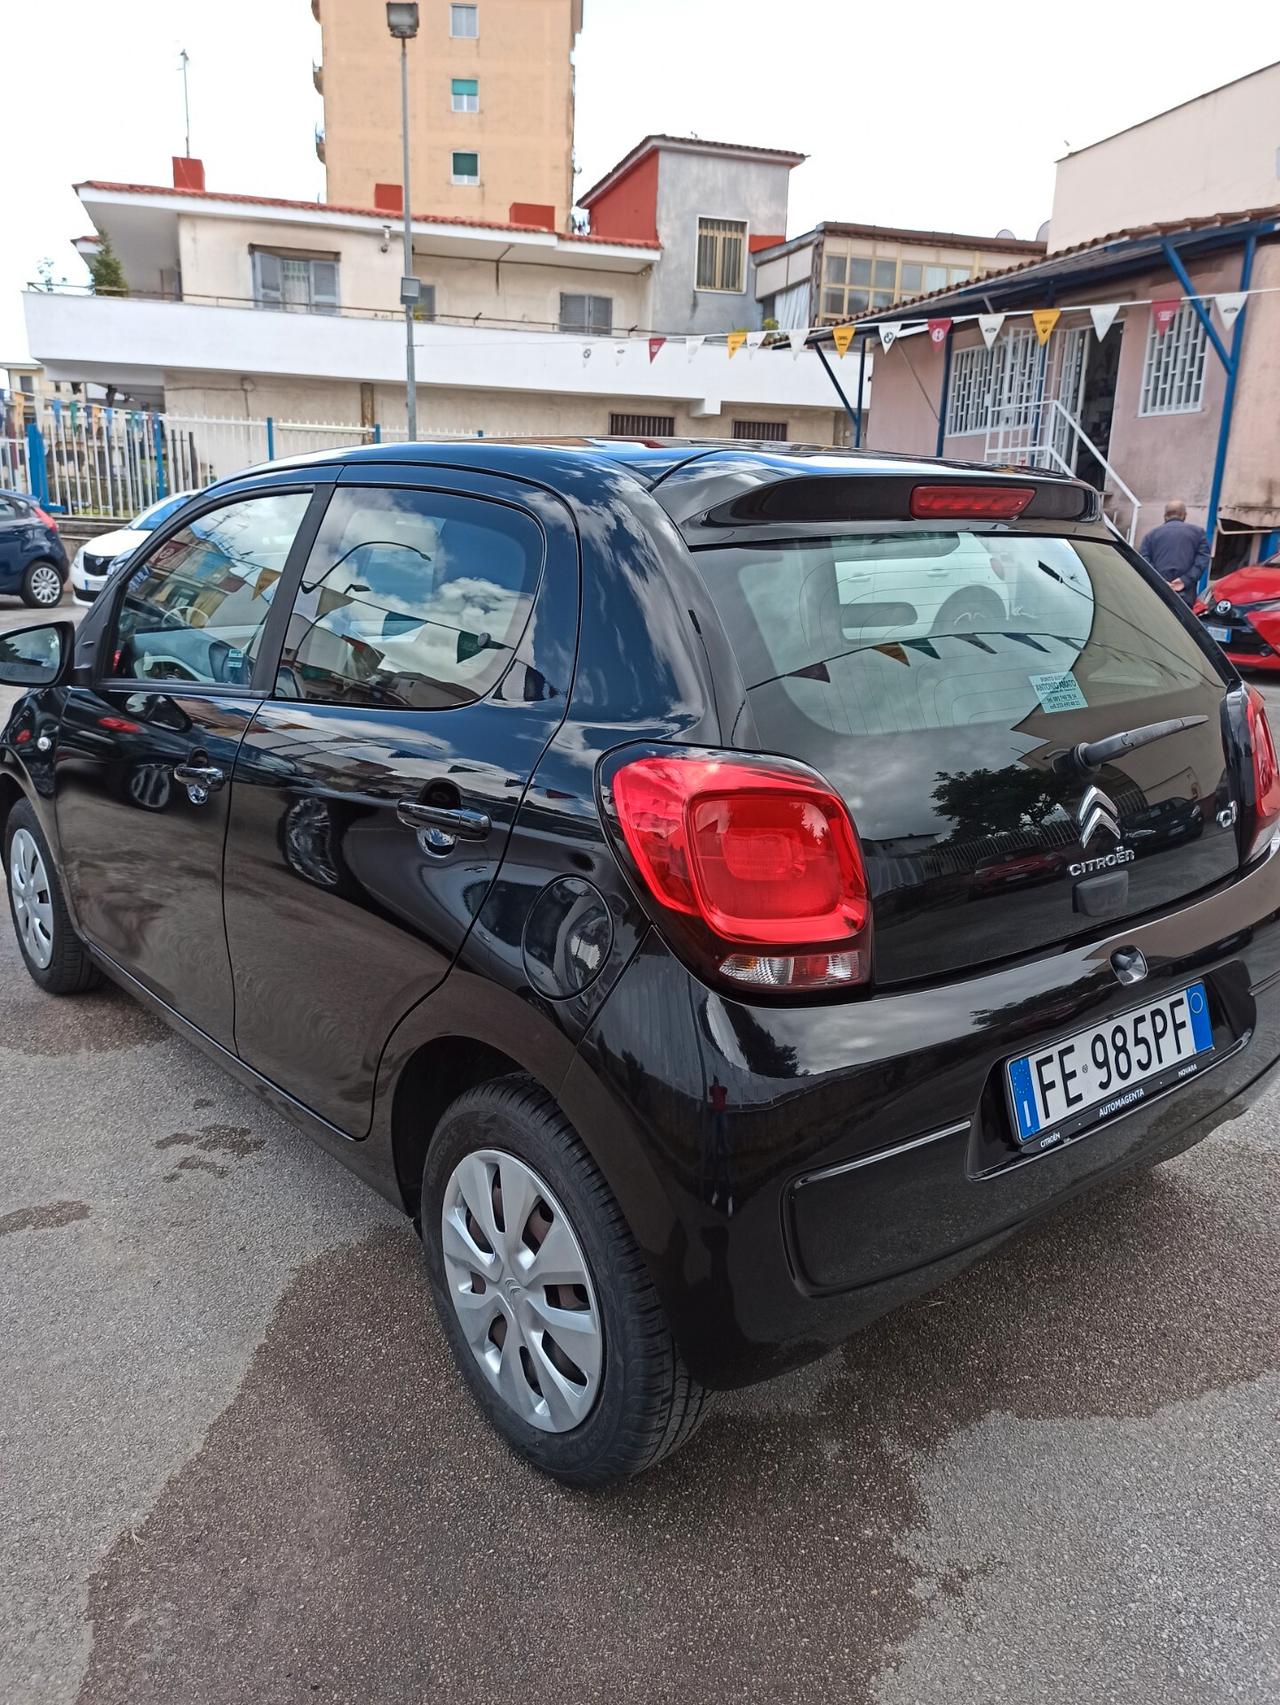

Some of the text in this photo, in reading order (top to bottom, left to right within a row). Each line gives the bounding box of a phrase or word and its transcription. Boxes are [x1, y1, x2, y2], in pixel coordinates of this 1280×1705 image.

[1069, 846, 1135, 877] CITROËN
[1035, 997, 1187, 1119] FE 985PF
[1098, 1087, 1145, 1118] AUTOMAGENTA
